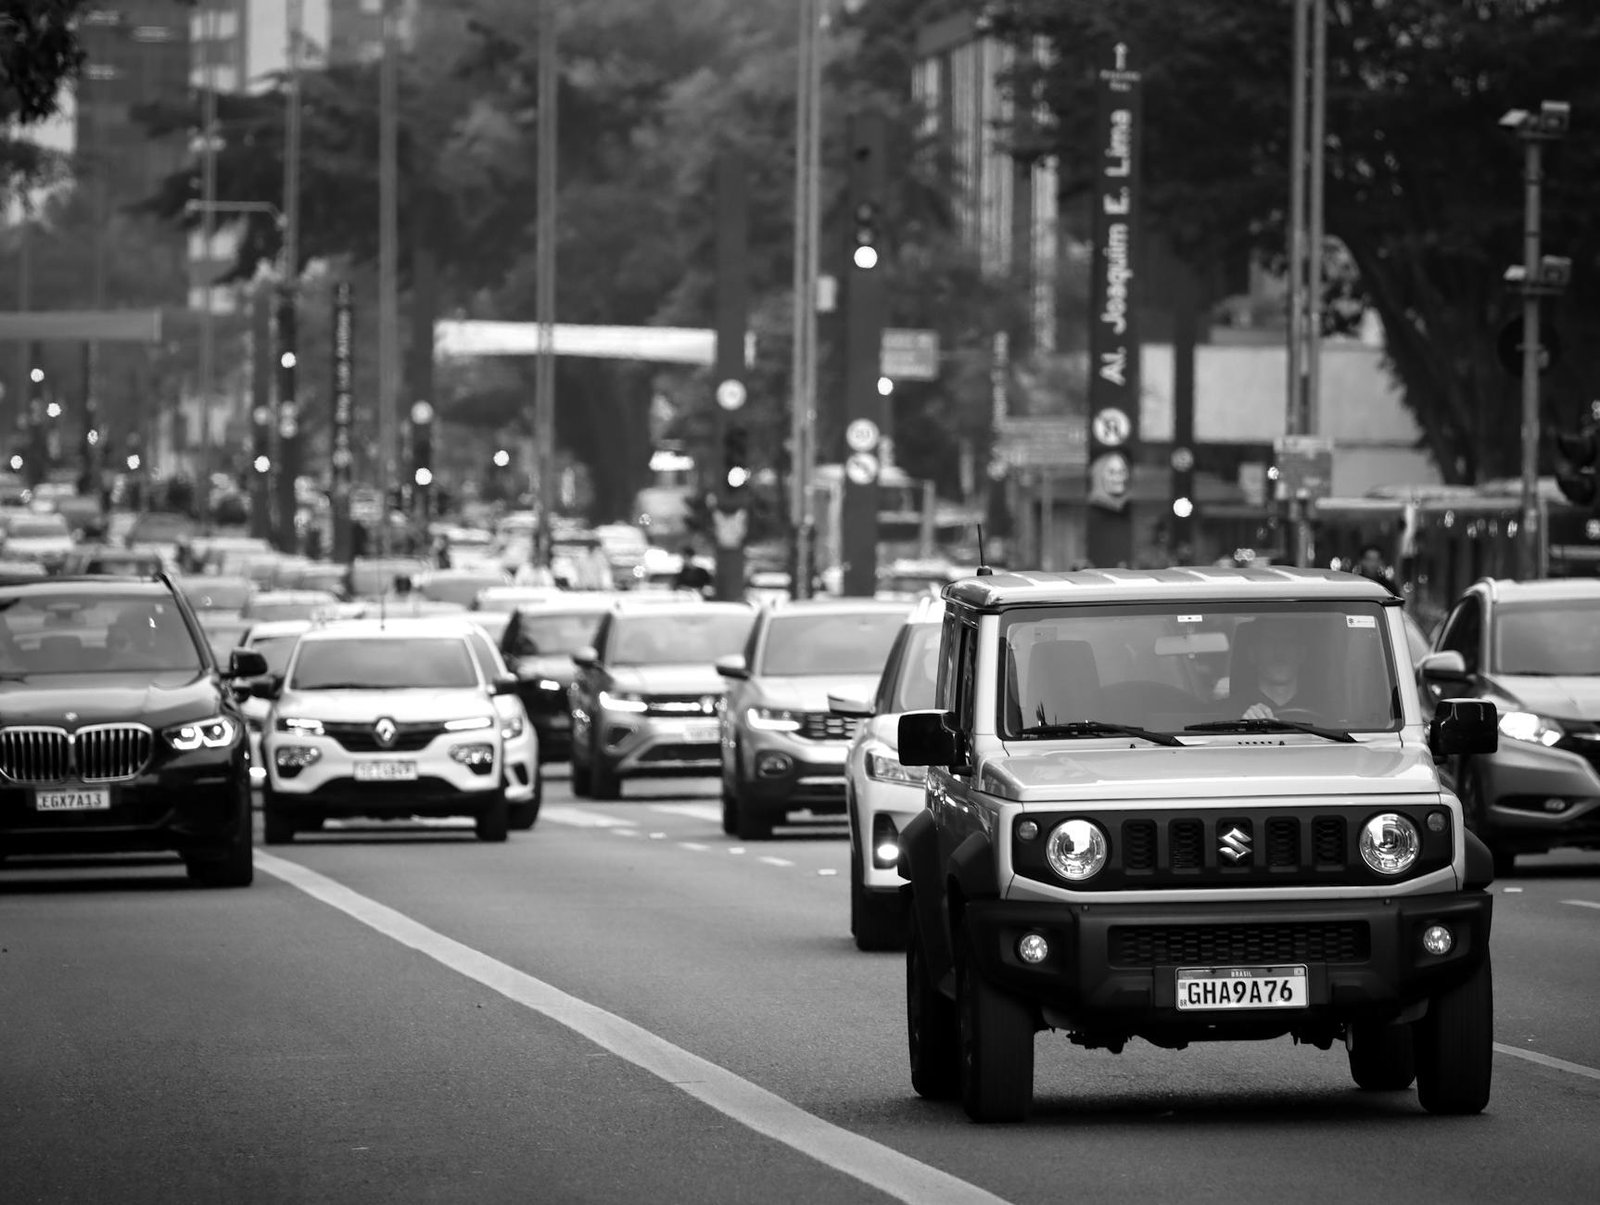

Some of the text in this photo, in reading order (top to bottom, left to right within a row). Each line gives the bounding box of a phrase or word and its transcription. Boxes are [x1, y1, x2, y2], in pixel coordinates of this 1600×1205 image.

[1105, 110, 1131, 178] Lima
[1103, 186, 1129, 216] E.
[1101, 222, 1133, 335] Joaquim
[1099, 346, 1127, 386] Al.
[1230, 970, 1252, 978] BRASIL
[1187, 980, 1293, 1005] GHA9A76
